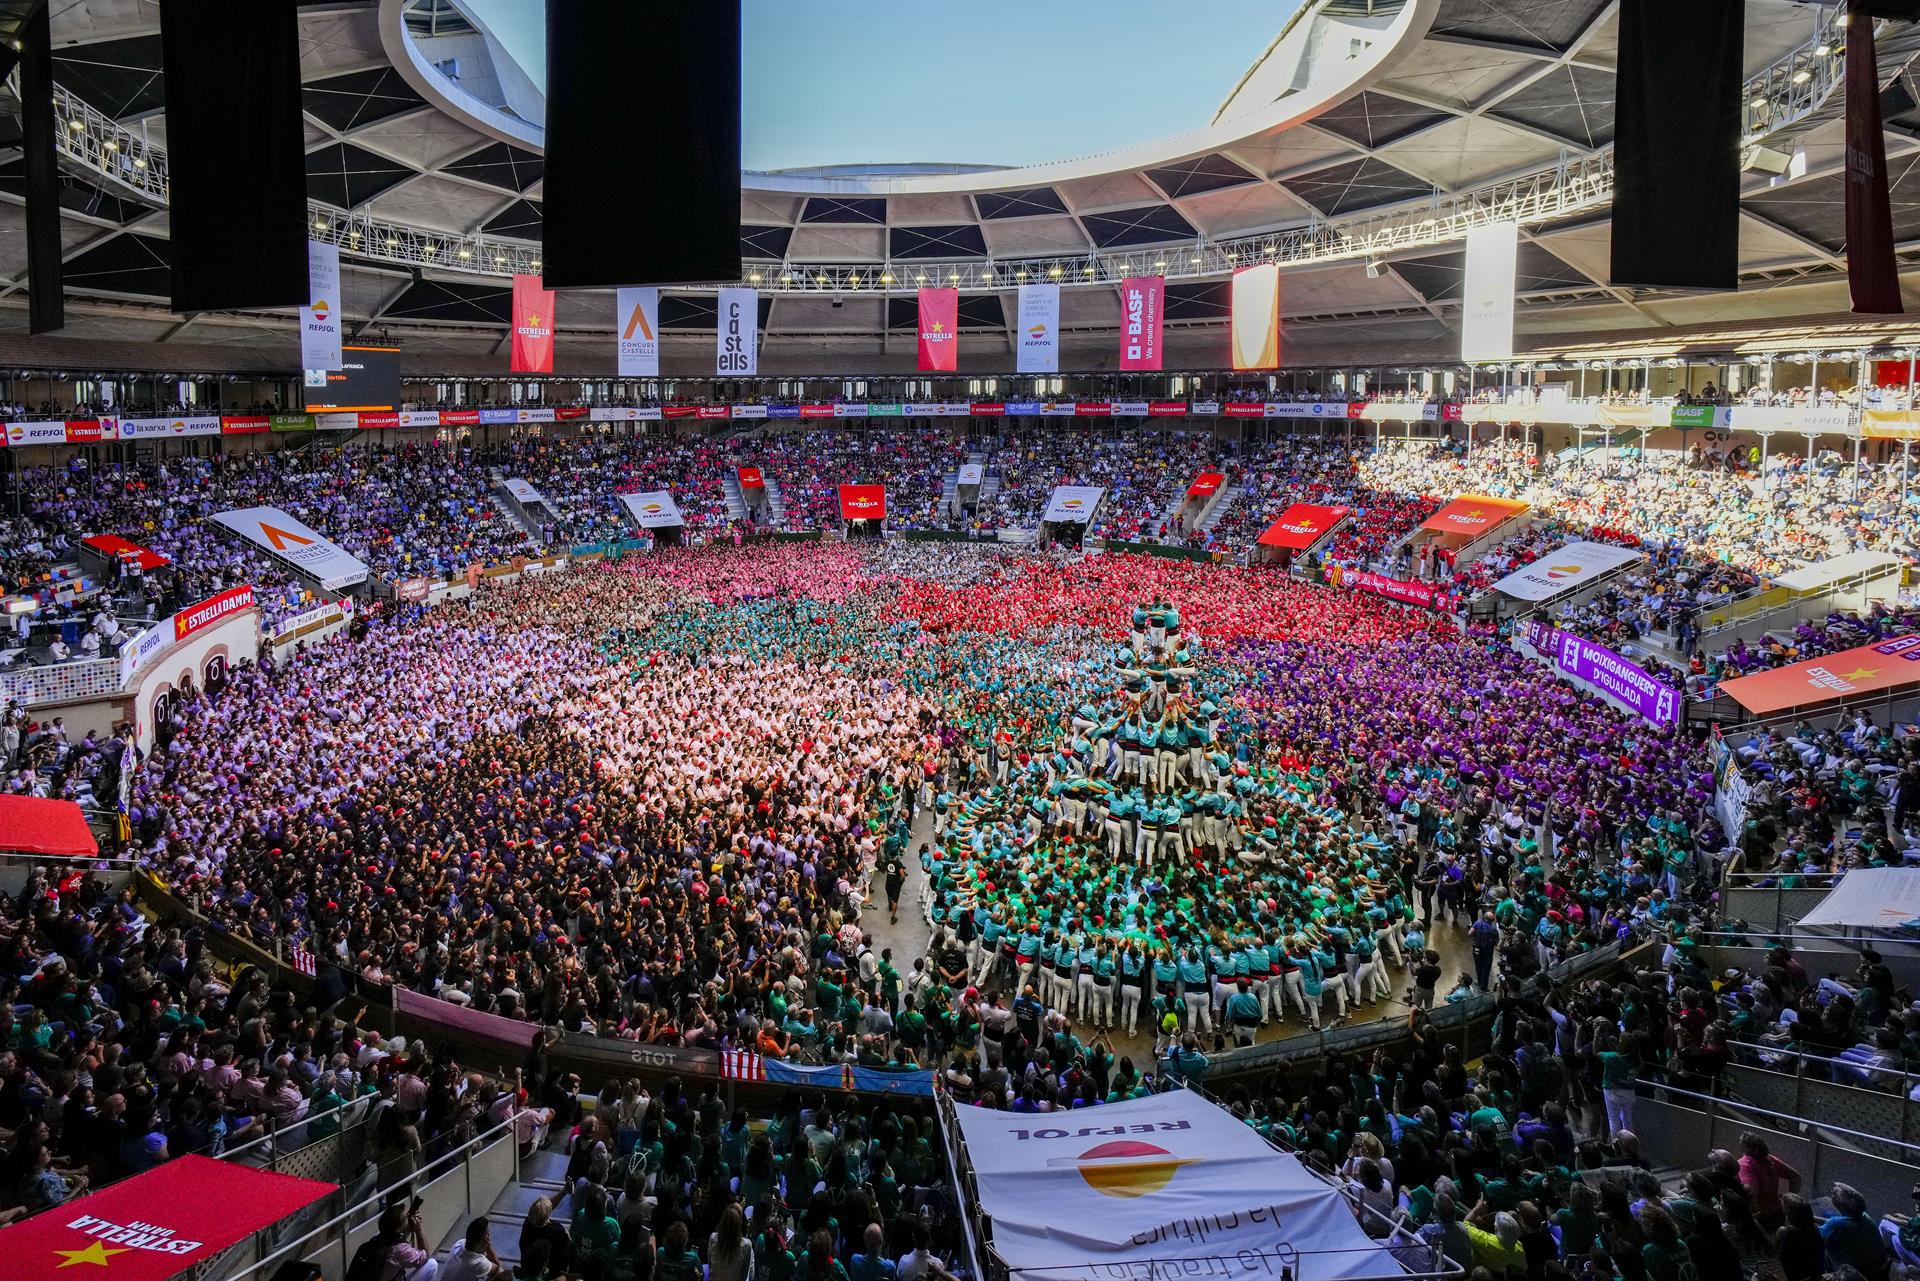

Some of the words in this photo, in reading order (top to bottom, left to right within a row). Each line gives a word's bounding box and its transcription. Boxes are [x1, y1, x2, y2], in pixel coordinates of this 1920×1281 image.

[1128, 289, 1143, 335] BASF
[1147, 288, 1155, 323] chemistry
[309, 323, 335, 333] REPSOL
[518, 327, 551, 335] ESTRELLA
[1146, 347, 1153, 359] We
[1676, 408, 1704, 416] BASF
[30, 429, 65, 437] REPSOL
[190, 422, 219, 430] REPSOL
[1281, 523, 1318, 533] ESTRELLA
[1448, 514, 1487, 524] ESTRELLA
[282, 543, 324, 556] CONCURS
[1523, 574, 1566, 589] REPSOL
[188, 605, 222, 630] ESTRELLA
[222, 592, 251, 612] DAMM
[140, 632, 160, 656] REPSOL
[1582, 646, 1656, 697] MOIXIGANGUERS
[1805, 667, 1856, 692] ESTRELLA
[1593, 667, 1641, 708] D'IGUALADA
[1008, 1120, 1192, 1141] REPSOL
[1249, 1204, 1282, 1228] la
[65, 1214, 204, 1255] ESTRELLA
[126, 1220, 176, 1237] DAMM
[1131, 1210, 1240, 1246] cultura
